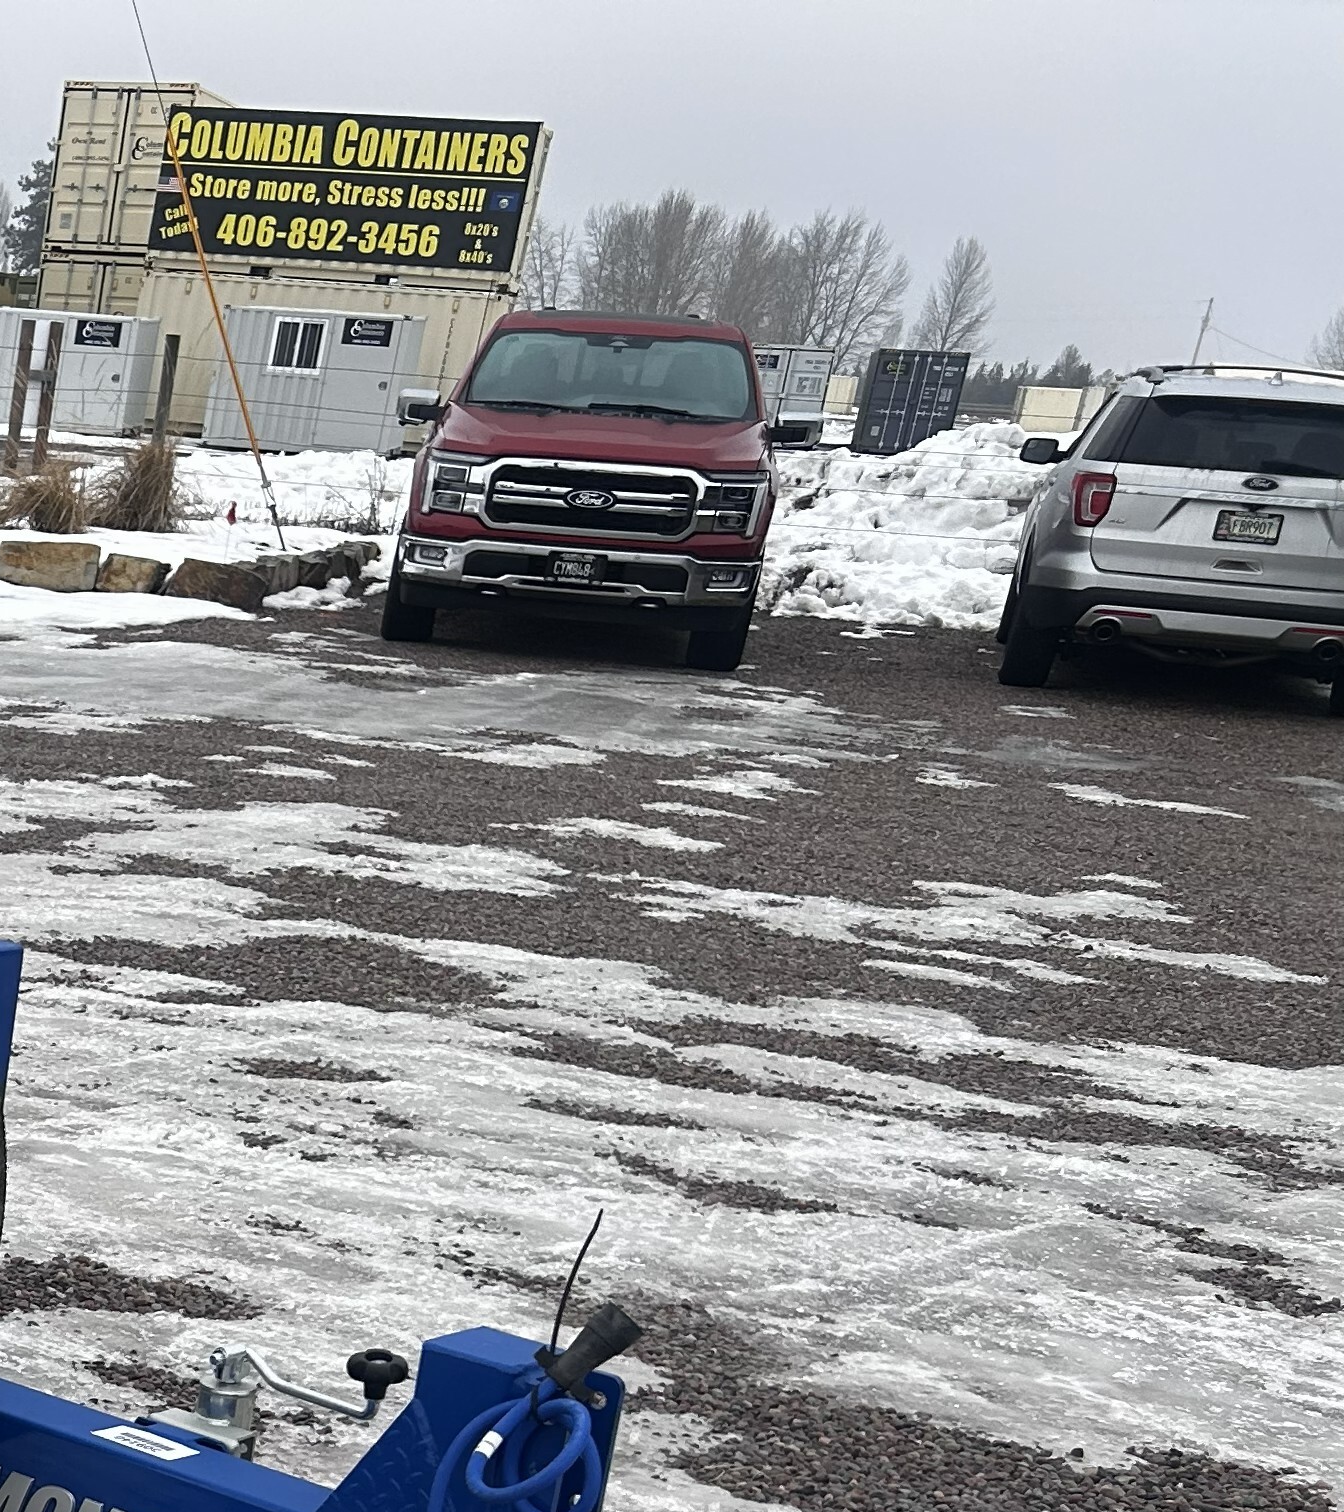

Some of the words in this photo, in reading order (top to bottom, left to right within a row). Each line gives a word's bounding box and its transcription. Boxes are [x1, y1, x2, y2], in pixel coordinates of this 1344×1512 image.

[166, 111, 324, 164] COLUMBIA
[332, 118, 529, 175] CONTAINERS
[165, 203, 188, 221] Call
[189, 172, 251, 200] Store
[255, 180, 321, 206] more,
[326, 179, 404, 208] Stress
[408, 184, 487, 213] less!!!
[216, 213, 441, 257] 406-892-3456
[575, 492, 605, 506] Ford
